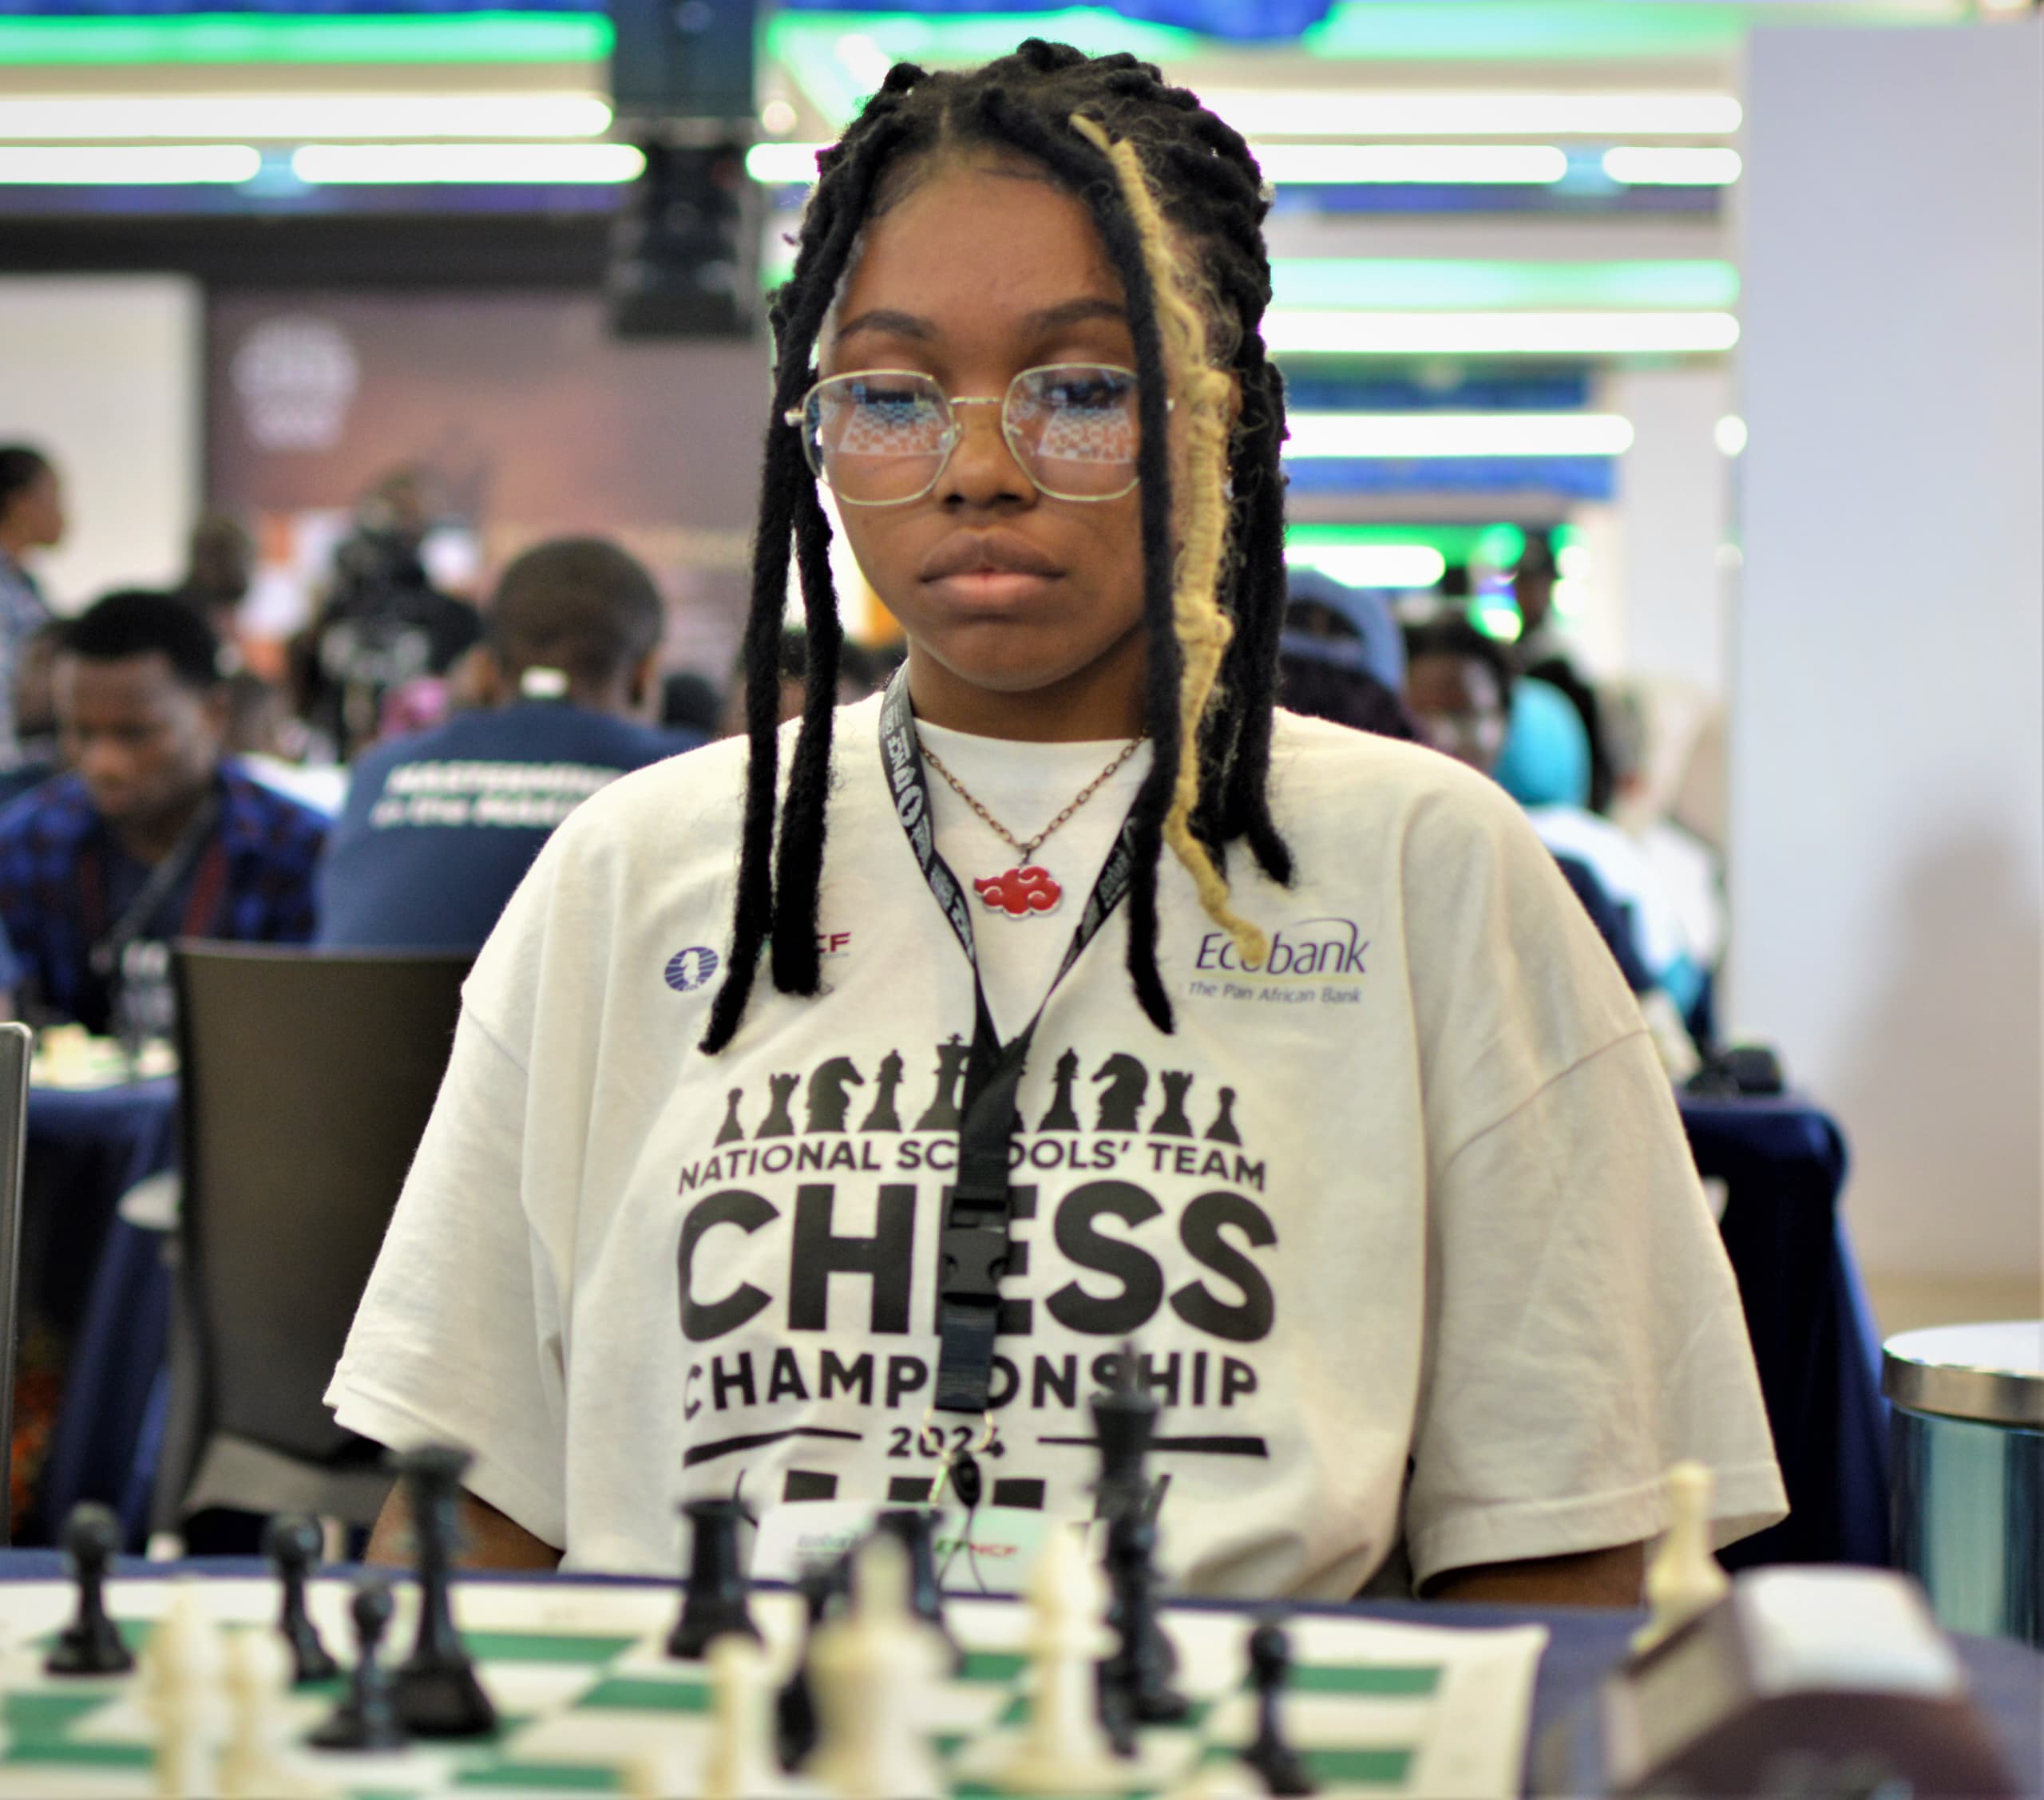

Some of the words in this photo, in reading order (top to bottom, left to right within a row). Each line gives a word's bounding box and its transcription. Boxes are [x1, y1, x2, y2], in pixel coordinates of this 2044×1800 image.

[1189, 981, 1217, 997] The
[1223, 983, 1253, 1001] Pan
[1259, 987, 1316, 1003] African
[1321, 986, 1362, 1005] Bank
[678, 1140, 881, 1197] NATIONAL
[896, 1138, 1131, 1171] SCOLS'
[1147, 1141, 1266, 1193] TEAM
[683, 1347, 1258, 1422] CHAMPONSHIP
[887, 1426, 1005, 1459] 2024
